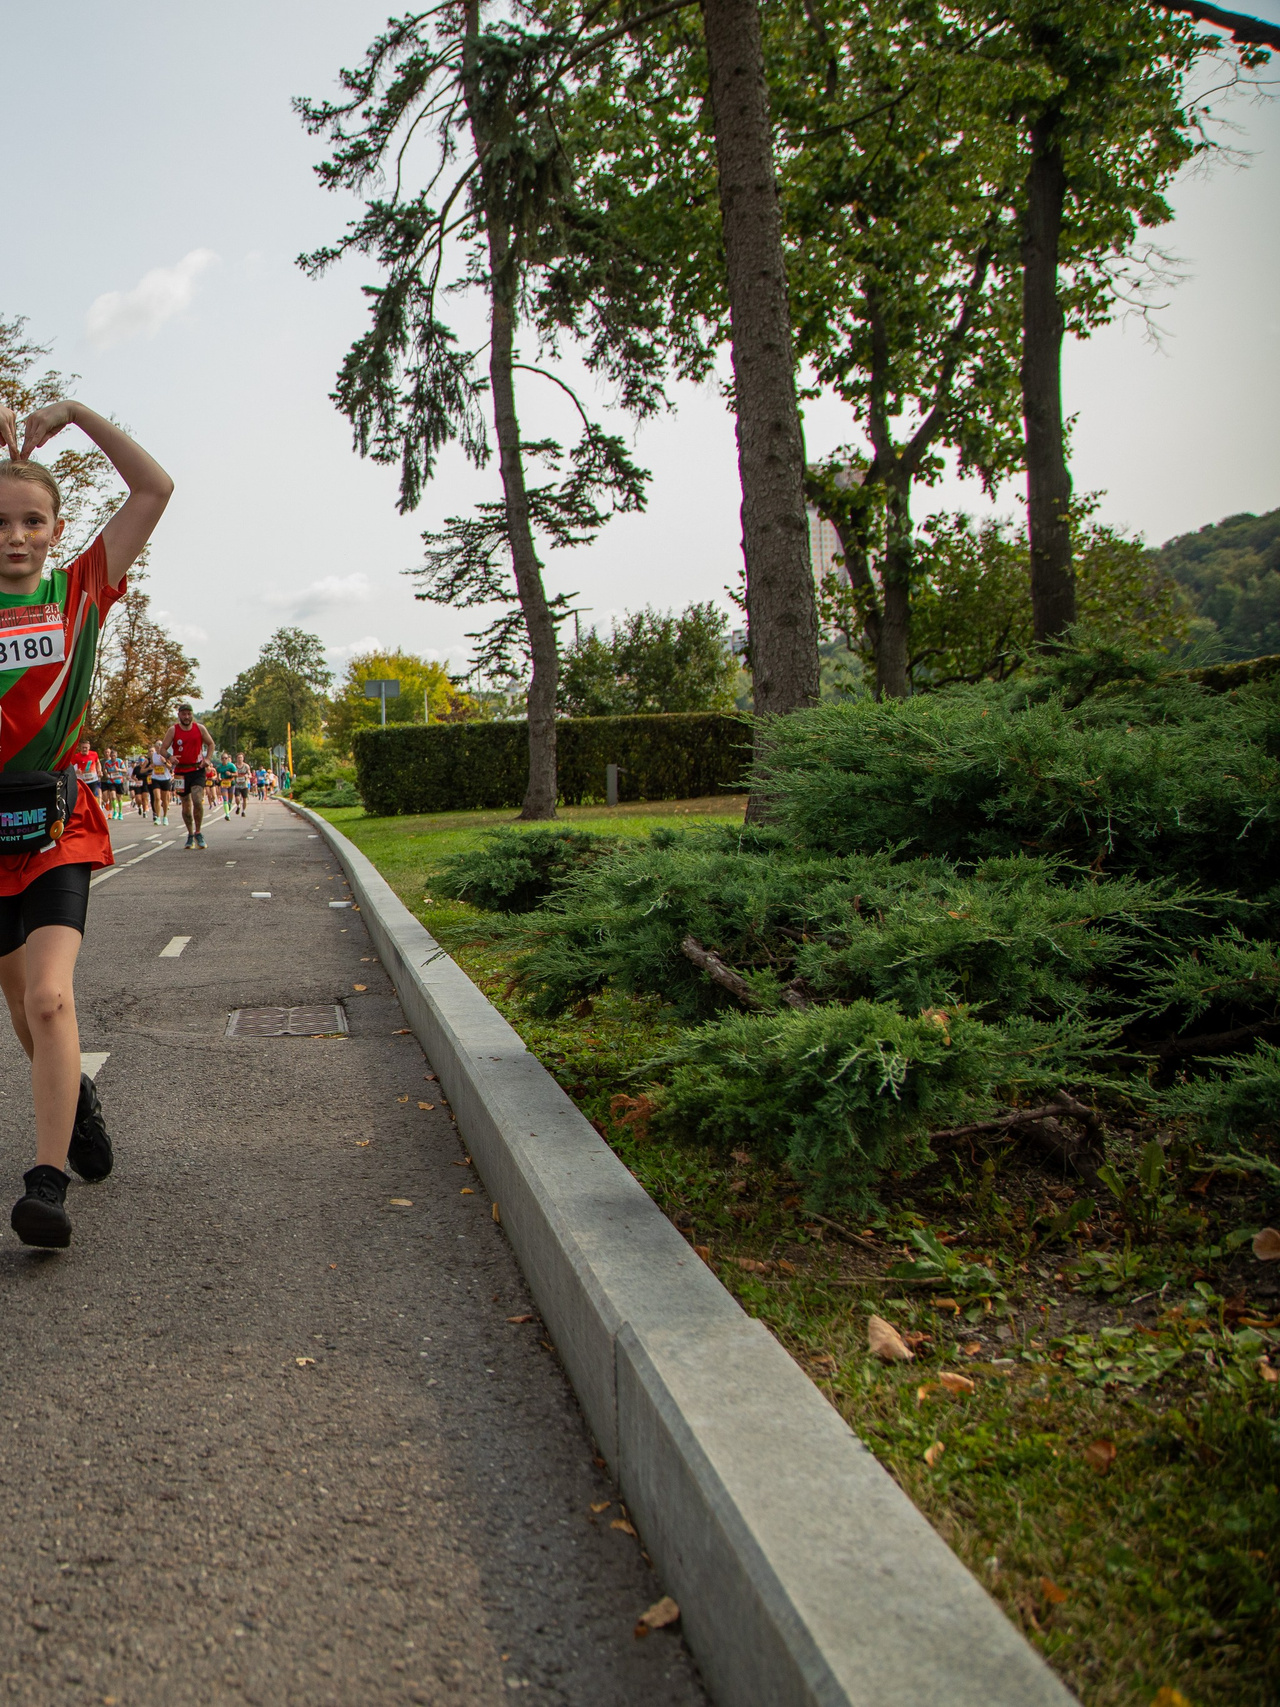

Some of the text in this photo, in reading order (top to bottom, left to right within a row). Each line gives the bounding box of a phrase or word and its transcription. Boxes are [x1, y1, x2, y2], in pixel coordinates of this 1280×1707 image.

[45, 604, 60, 614] 21,1
[9, 828, 16, 836] &
[16, 826, 37, 835] POLE
